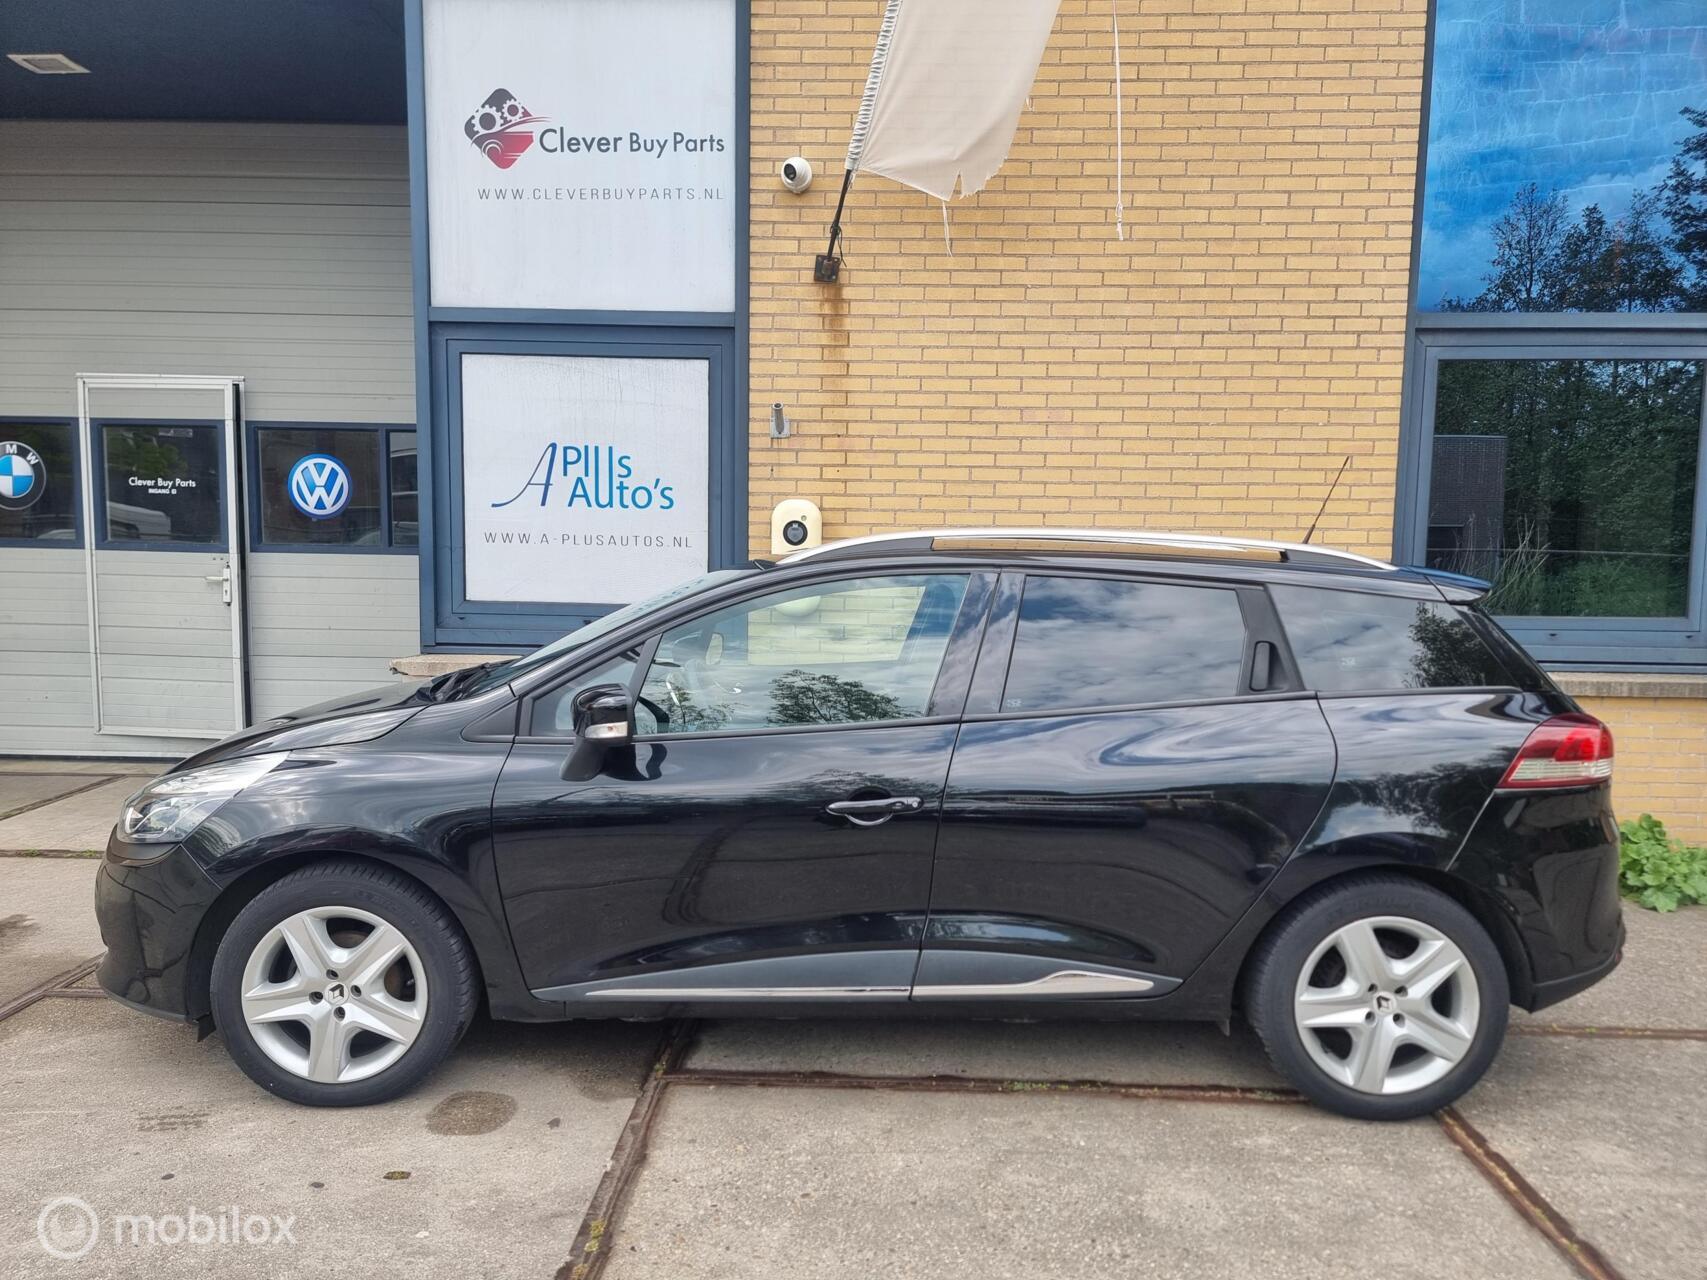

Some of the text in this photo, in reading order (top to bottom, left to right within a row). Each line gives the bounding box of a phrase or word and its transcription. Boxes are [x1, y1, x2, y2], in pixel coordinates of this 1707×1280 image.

[539, 126, 725, 158] Clever Buy Parts
[478, 188, 724, 201] WWW.CLEVERBUYPARTS.NL
[128, 477, 196, 488] Clever Buy Parts
[484, 532, 692, 548] WWW.A-PLUSAUTOS.NL
